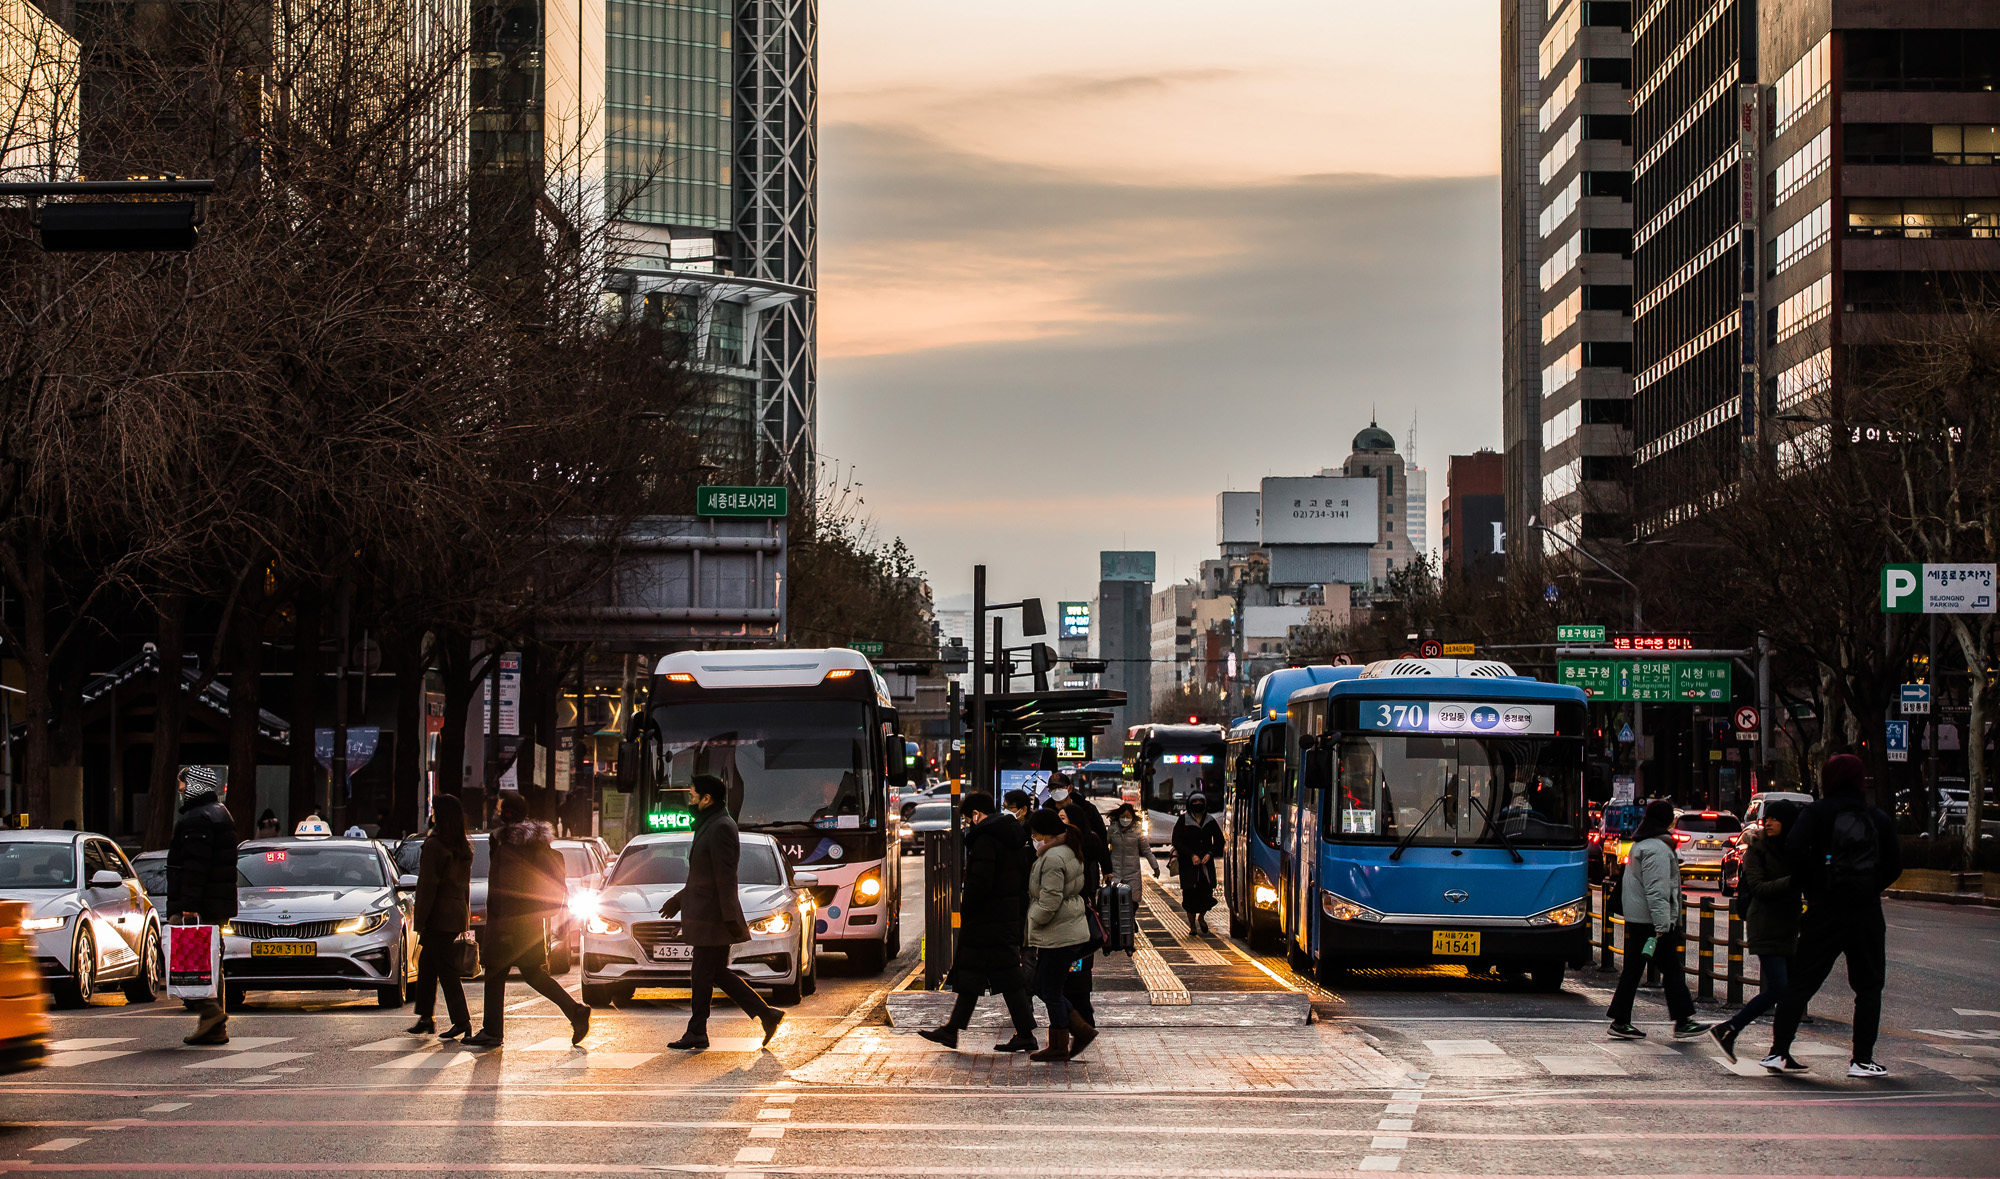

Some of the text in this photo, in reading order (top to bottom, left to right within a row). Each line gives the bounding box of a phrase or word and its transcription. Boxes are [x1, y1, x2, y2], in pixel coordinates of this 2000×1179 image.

[708, 493, 776, 509] 세종대로사거리
[1294, 499, 1349, 508] 광고문의
[1293, 510, 1349, 518] 02)734-3141
[1886, 569, 1916, 608] P
[1560, 629, 1604, 639] 종로구청입구
[1425, 645, 1437, 656] 50
[1565, 667, 1610, 679] 종로구청
[1632, 663, 1671, 674] 흥인지문
[1680, 668, 1703, 679] 시청
[1376, 704, 1424, 728] 370
[1440, 712, 1466, 722] 강일동
[1473, 712, 1497, 722] 종로
[1504, 714, 1531, 723] 충정로역
[285, 944, 312, 955] 3110
[659, 947, 679, 957] 43수
[1446, 941, 1477, 953] 1541
